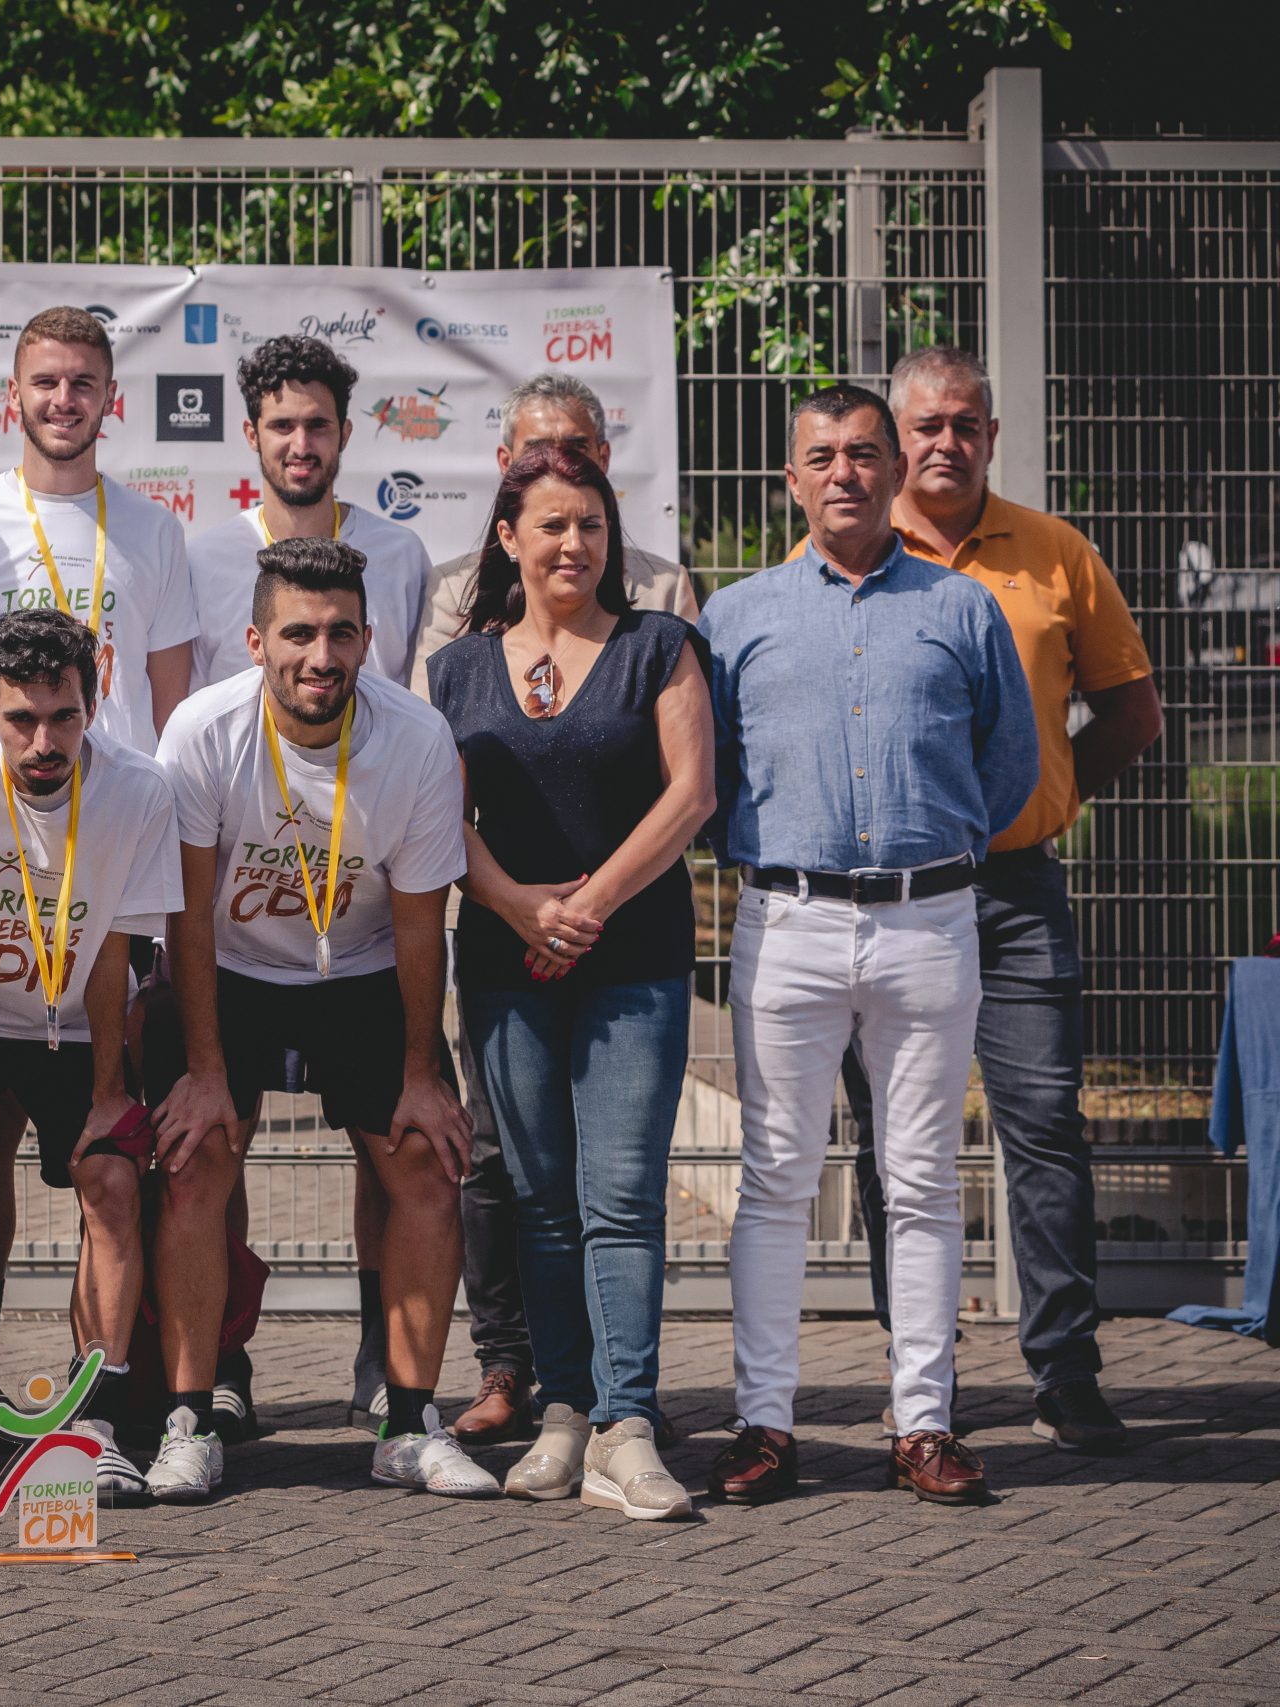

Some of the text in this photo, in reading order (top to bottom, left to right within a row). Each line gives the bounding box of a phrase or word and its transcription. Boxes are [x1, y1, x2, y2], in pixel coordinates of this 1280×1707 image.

[553, 304, 607, 318] TORNEIO
[137, 325, 161, 333] VIVO
[544, 319, 601, 336] FUTEBOL
[546, 331, 613, 362] CDM
[136, 465, 190, 480] TORNEIO
[424, 491, 439, 500] AO
[442, 491, 467, 500] VIVO
[104, 620, 114, 640] 5
[230, 880, 354, 923] CDM
[67, 928, 84, 947] 5
[23, 1480, 94, 1500] TORNEIO
[23, 1498, 95, 1516] FUTEBOL 5
[24, 1511, 94, 1545] CDM
